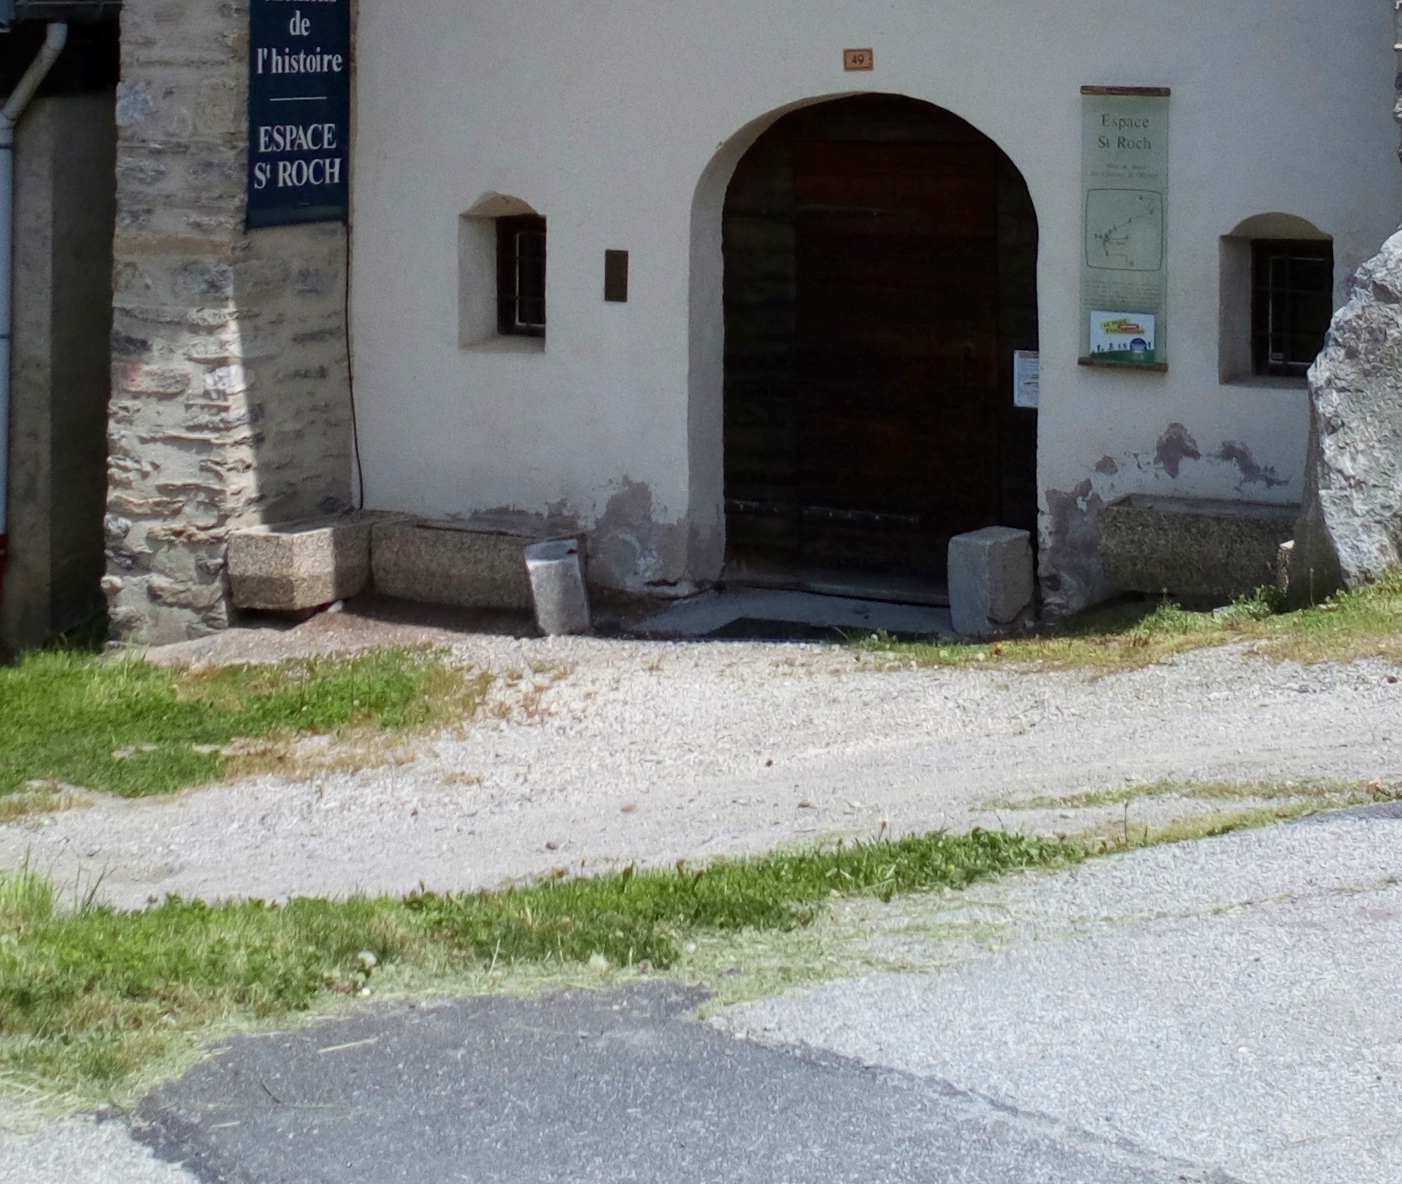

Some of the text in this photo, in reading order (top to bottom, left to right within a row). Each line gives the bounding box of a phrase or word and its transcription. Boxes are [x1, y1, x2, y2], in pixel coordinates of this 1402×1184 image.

[289, 10, 311, 37] de
[256, 47, 344, 75] l'histoire
[851, 53, 865, 65] 49
[1101, 113, 1150, 131] Espace
[257, 123, 338, 154] ESPACE
[1117, 135, 1152, 150] Roch
[253, 157, 343, 190] St ROCH
